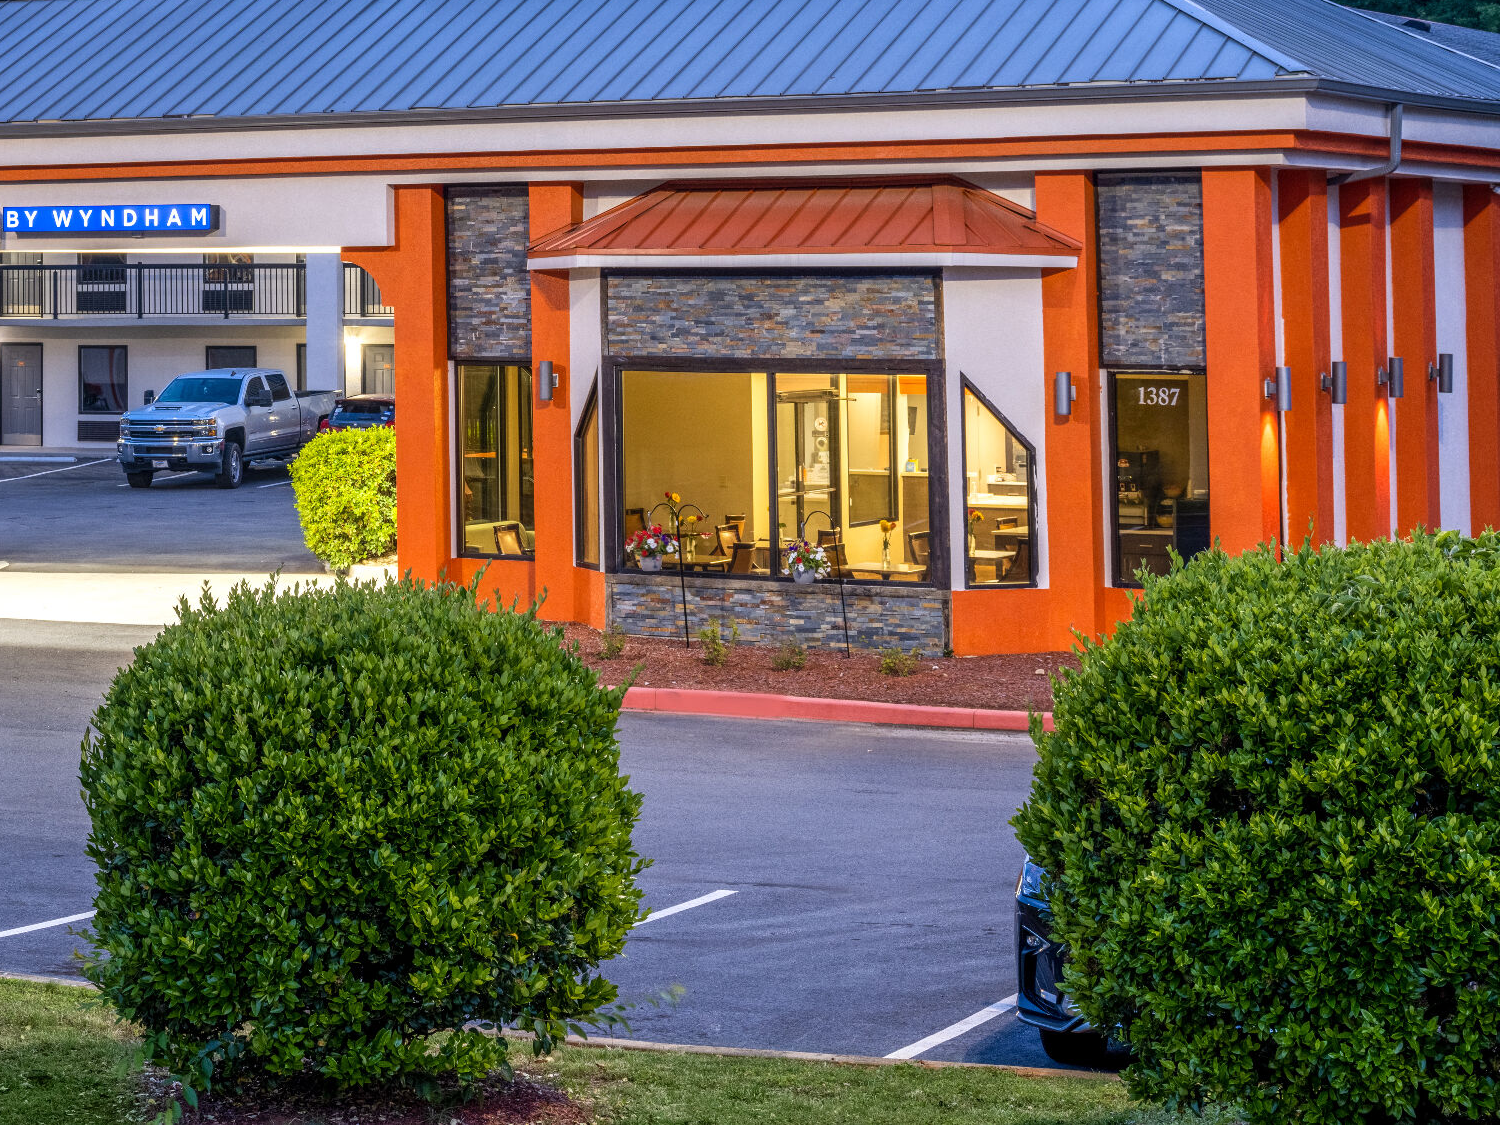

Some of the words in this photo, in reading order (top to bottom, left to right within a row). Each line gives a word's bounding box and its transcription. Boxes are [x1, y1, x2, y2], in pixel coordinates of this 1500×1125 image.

[6, 210, 38, 228] BY
[52, 207, 208, 228] WYNDHAM
[1138, 386, 1180, 406] 1387
